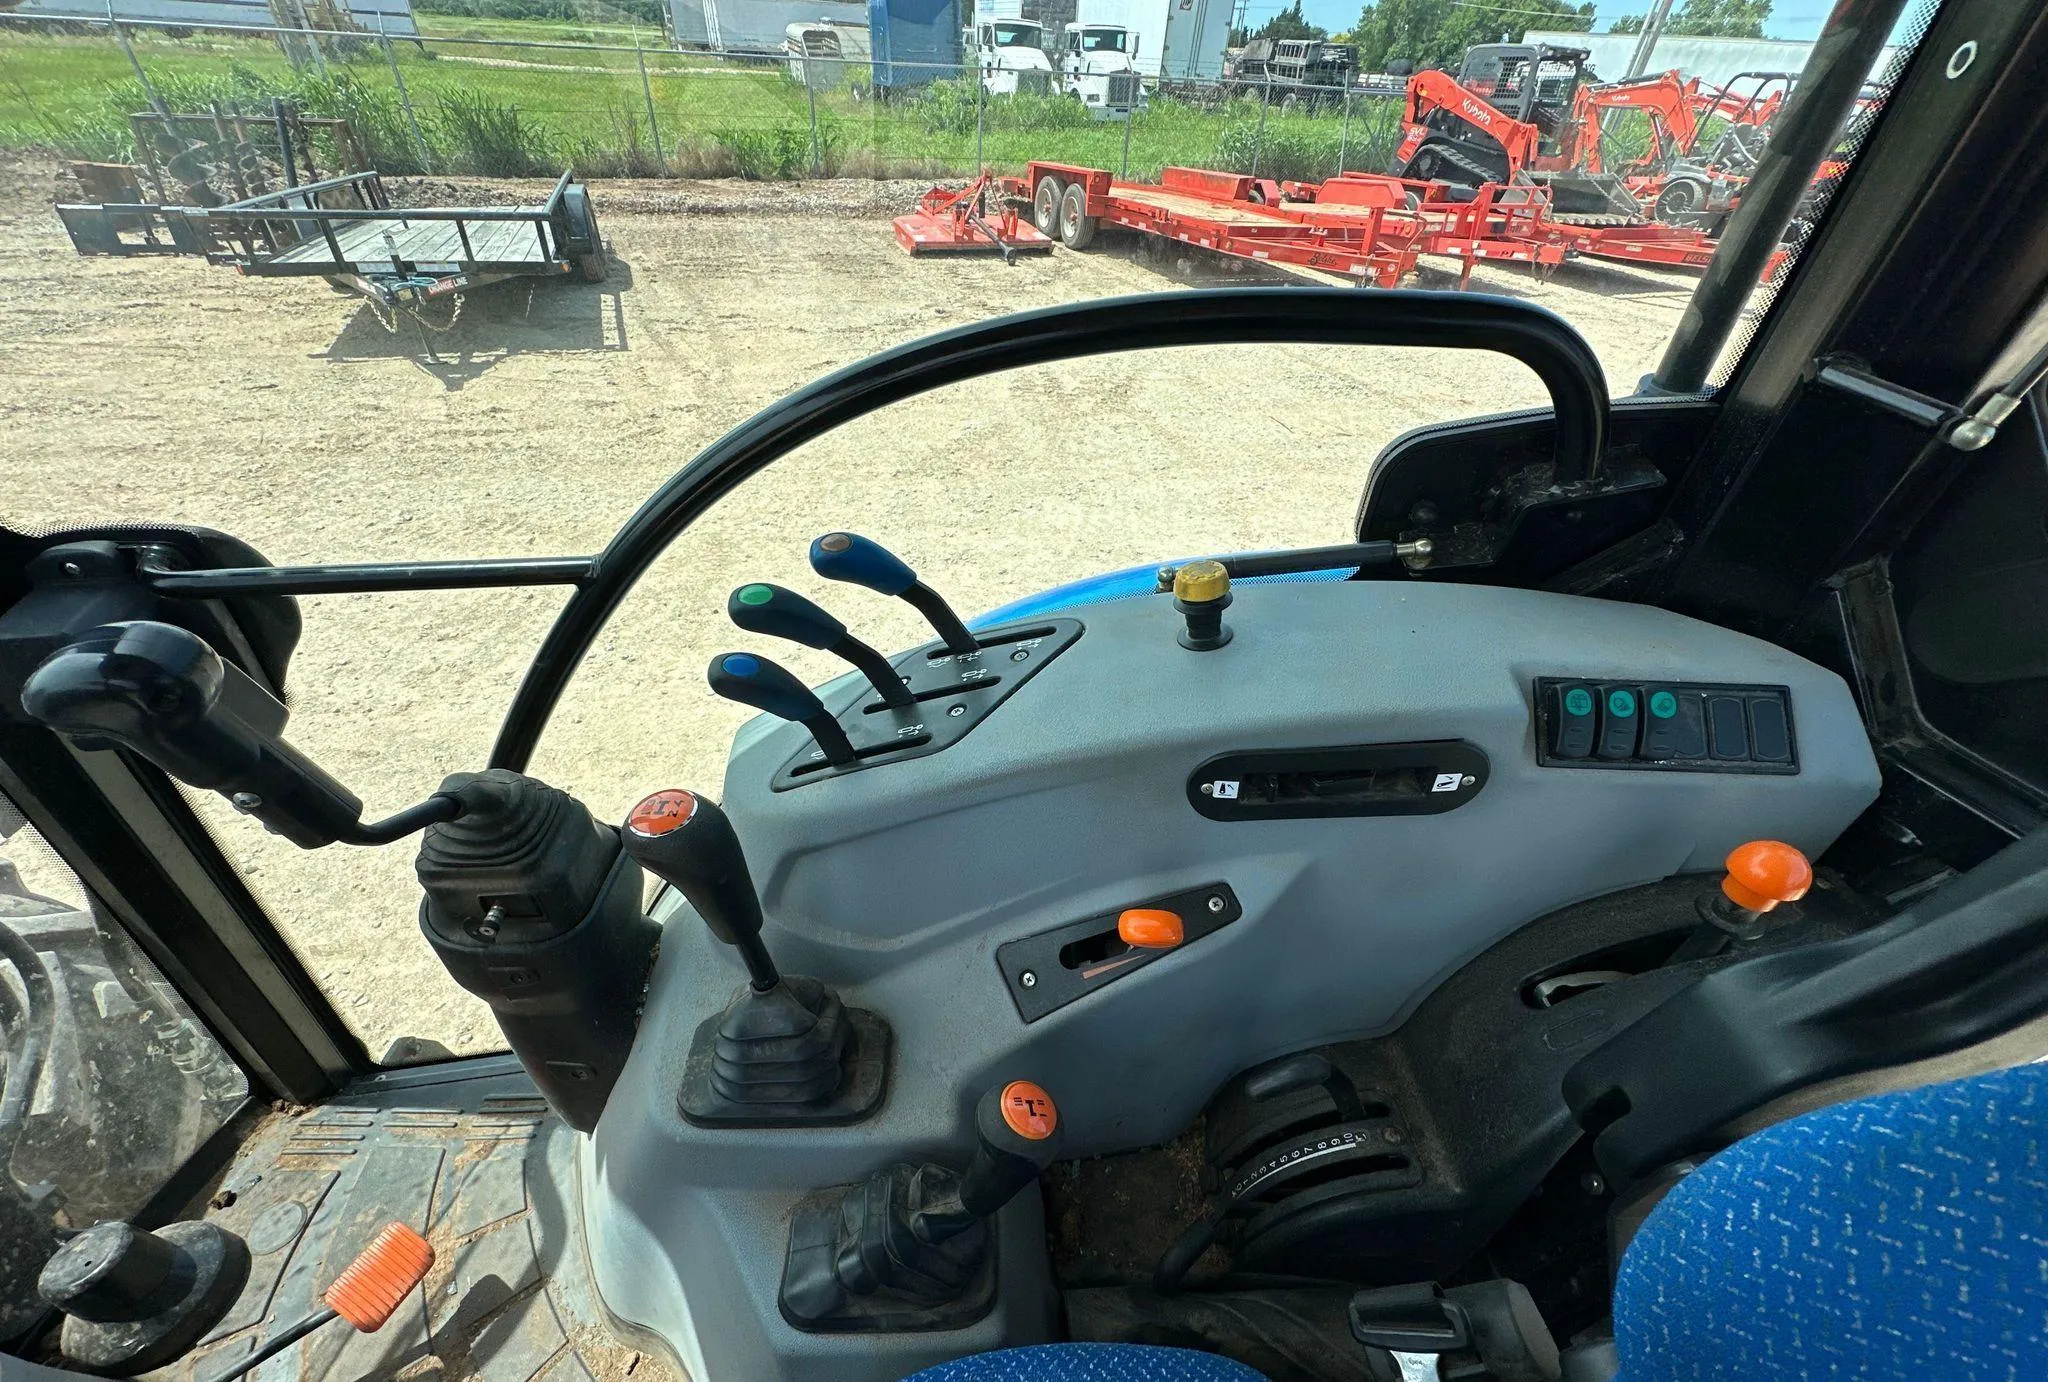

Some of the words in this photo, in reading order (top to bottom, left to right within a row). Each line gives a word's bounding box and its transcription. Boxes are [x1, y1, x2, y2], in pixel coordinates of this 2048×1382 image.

[1462, 98, 1493, 126] Kubota
[452, 276, 468, 288] LINE
[1259, 1166, 1267, 1174] 3
[1269, 1160, 1277, 1168] 4
[1279, 1155, 1288, 1163] 5
[1291, 1150, 1300, 1158] 6
[1317, 1141, 1327, 1150] 8
[1330, 1138, 1341, 1146] 9
[1343, 1132, 1354, 1143] 10
